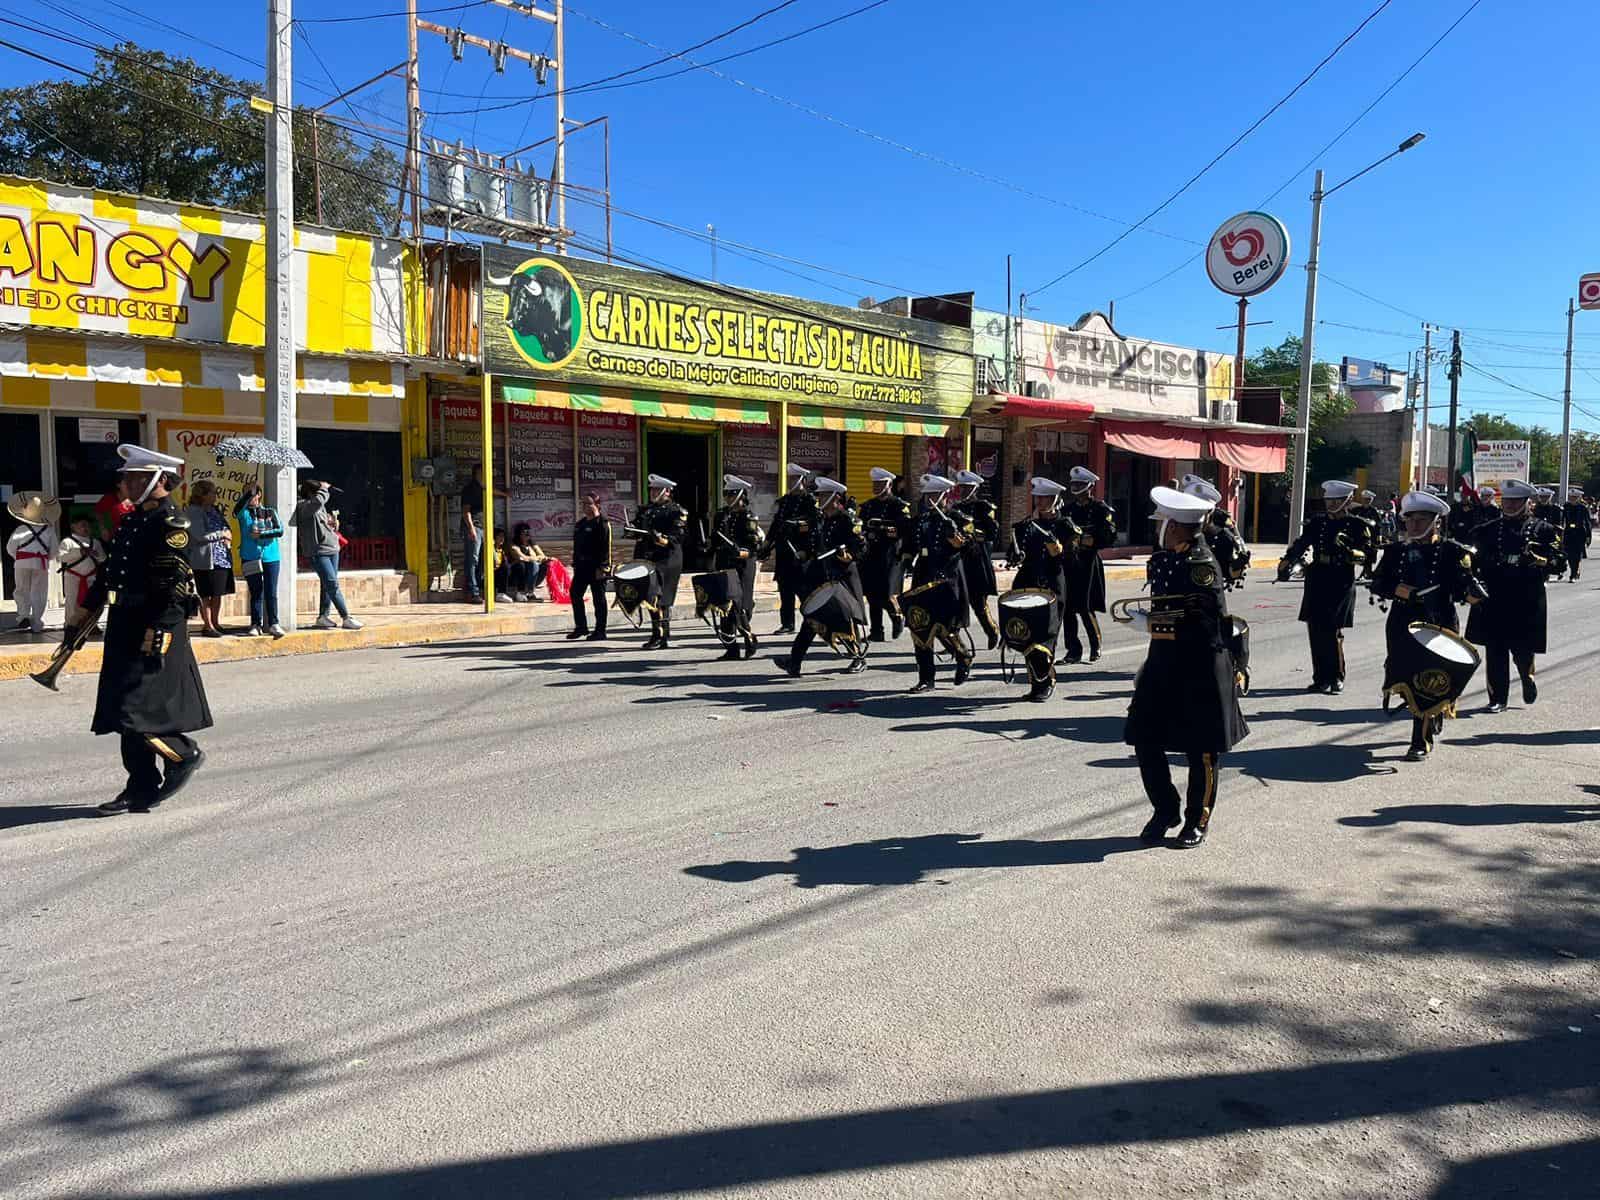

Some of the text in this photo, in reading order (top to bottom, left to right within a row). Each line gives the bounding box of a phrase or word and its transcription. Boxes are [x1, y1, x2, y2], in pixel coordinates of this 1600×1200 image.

[1232, 253, 1273, 285] Berel
[66, 293, 189, 324] CHICKEN
[588, 290, 923, 380] CARNES SELECTAS DE ACUÑA
[1055, 330, 1207, 381] FRANCISCO
[587, 349, 838, 395] Carnes de la Mejor Calidad e Higiene
[440, 405, 478, 420] aquete
[513, 407, 550, 422] Paquete
[581, 414, 614, 427] Paquete
